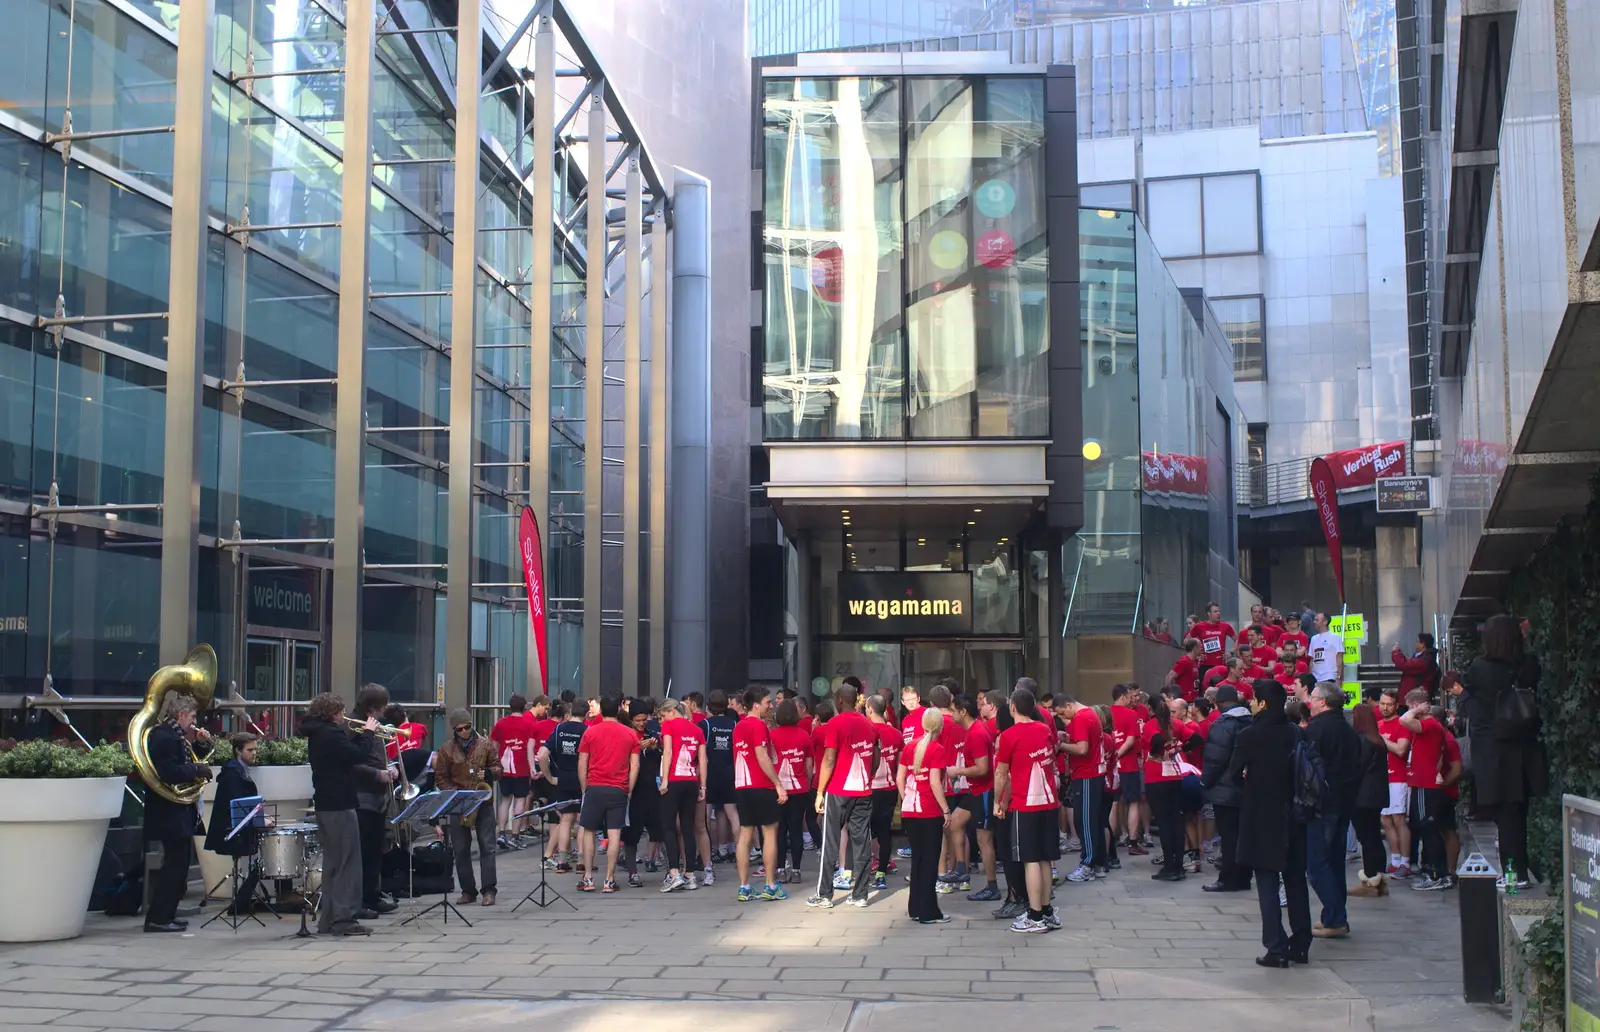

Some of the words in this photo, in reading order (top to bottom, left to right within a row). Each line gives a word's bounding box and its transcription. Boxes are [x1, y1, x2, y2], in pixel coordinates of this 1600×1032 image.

[1343, 446, 1382, 476] Vertical
[1373, 449, 1401, 472] Rush
[1384, 479, 1423, 488] Bannatyne's
[1316, 480, 1337, 538] Shelter
[524, 537, 542, 617] Shelter
[254, 581, 312, 613] welcome
[849, 599, 963, 620] wagamama
[851, 740, 867, 749] Vertical
[1028, 746, 1048, 758] Vertical
[1588, 857, 1600, 881] Clu
